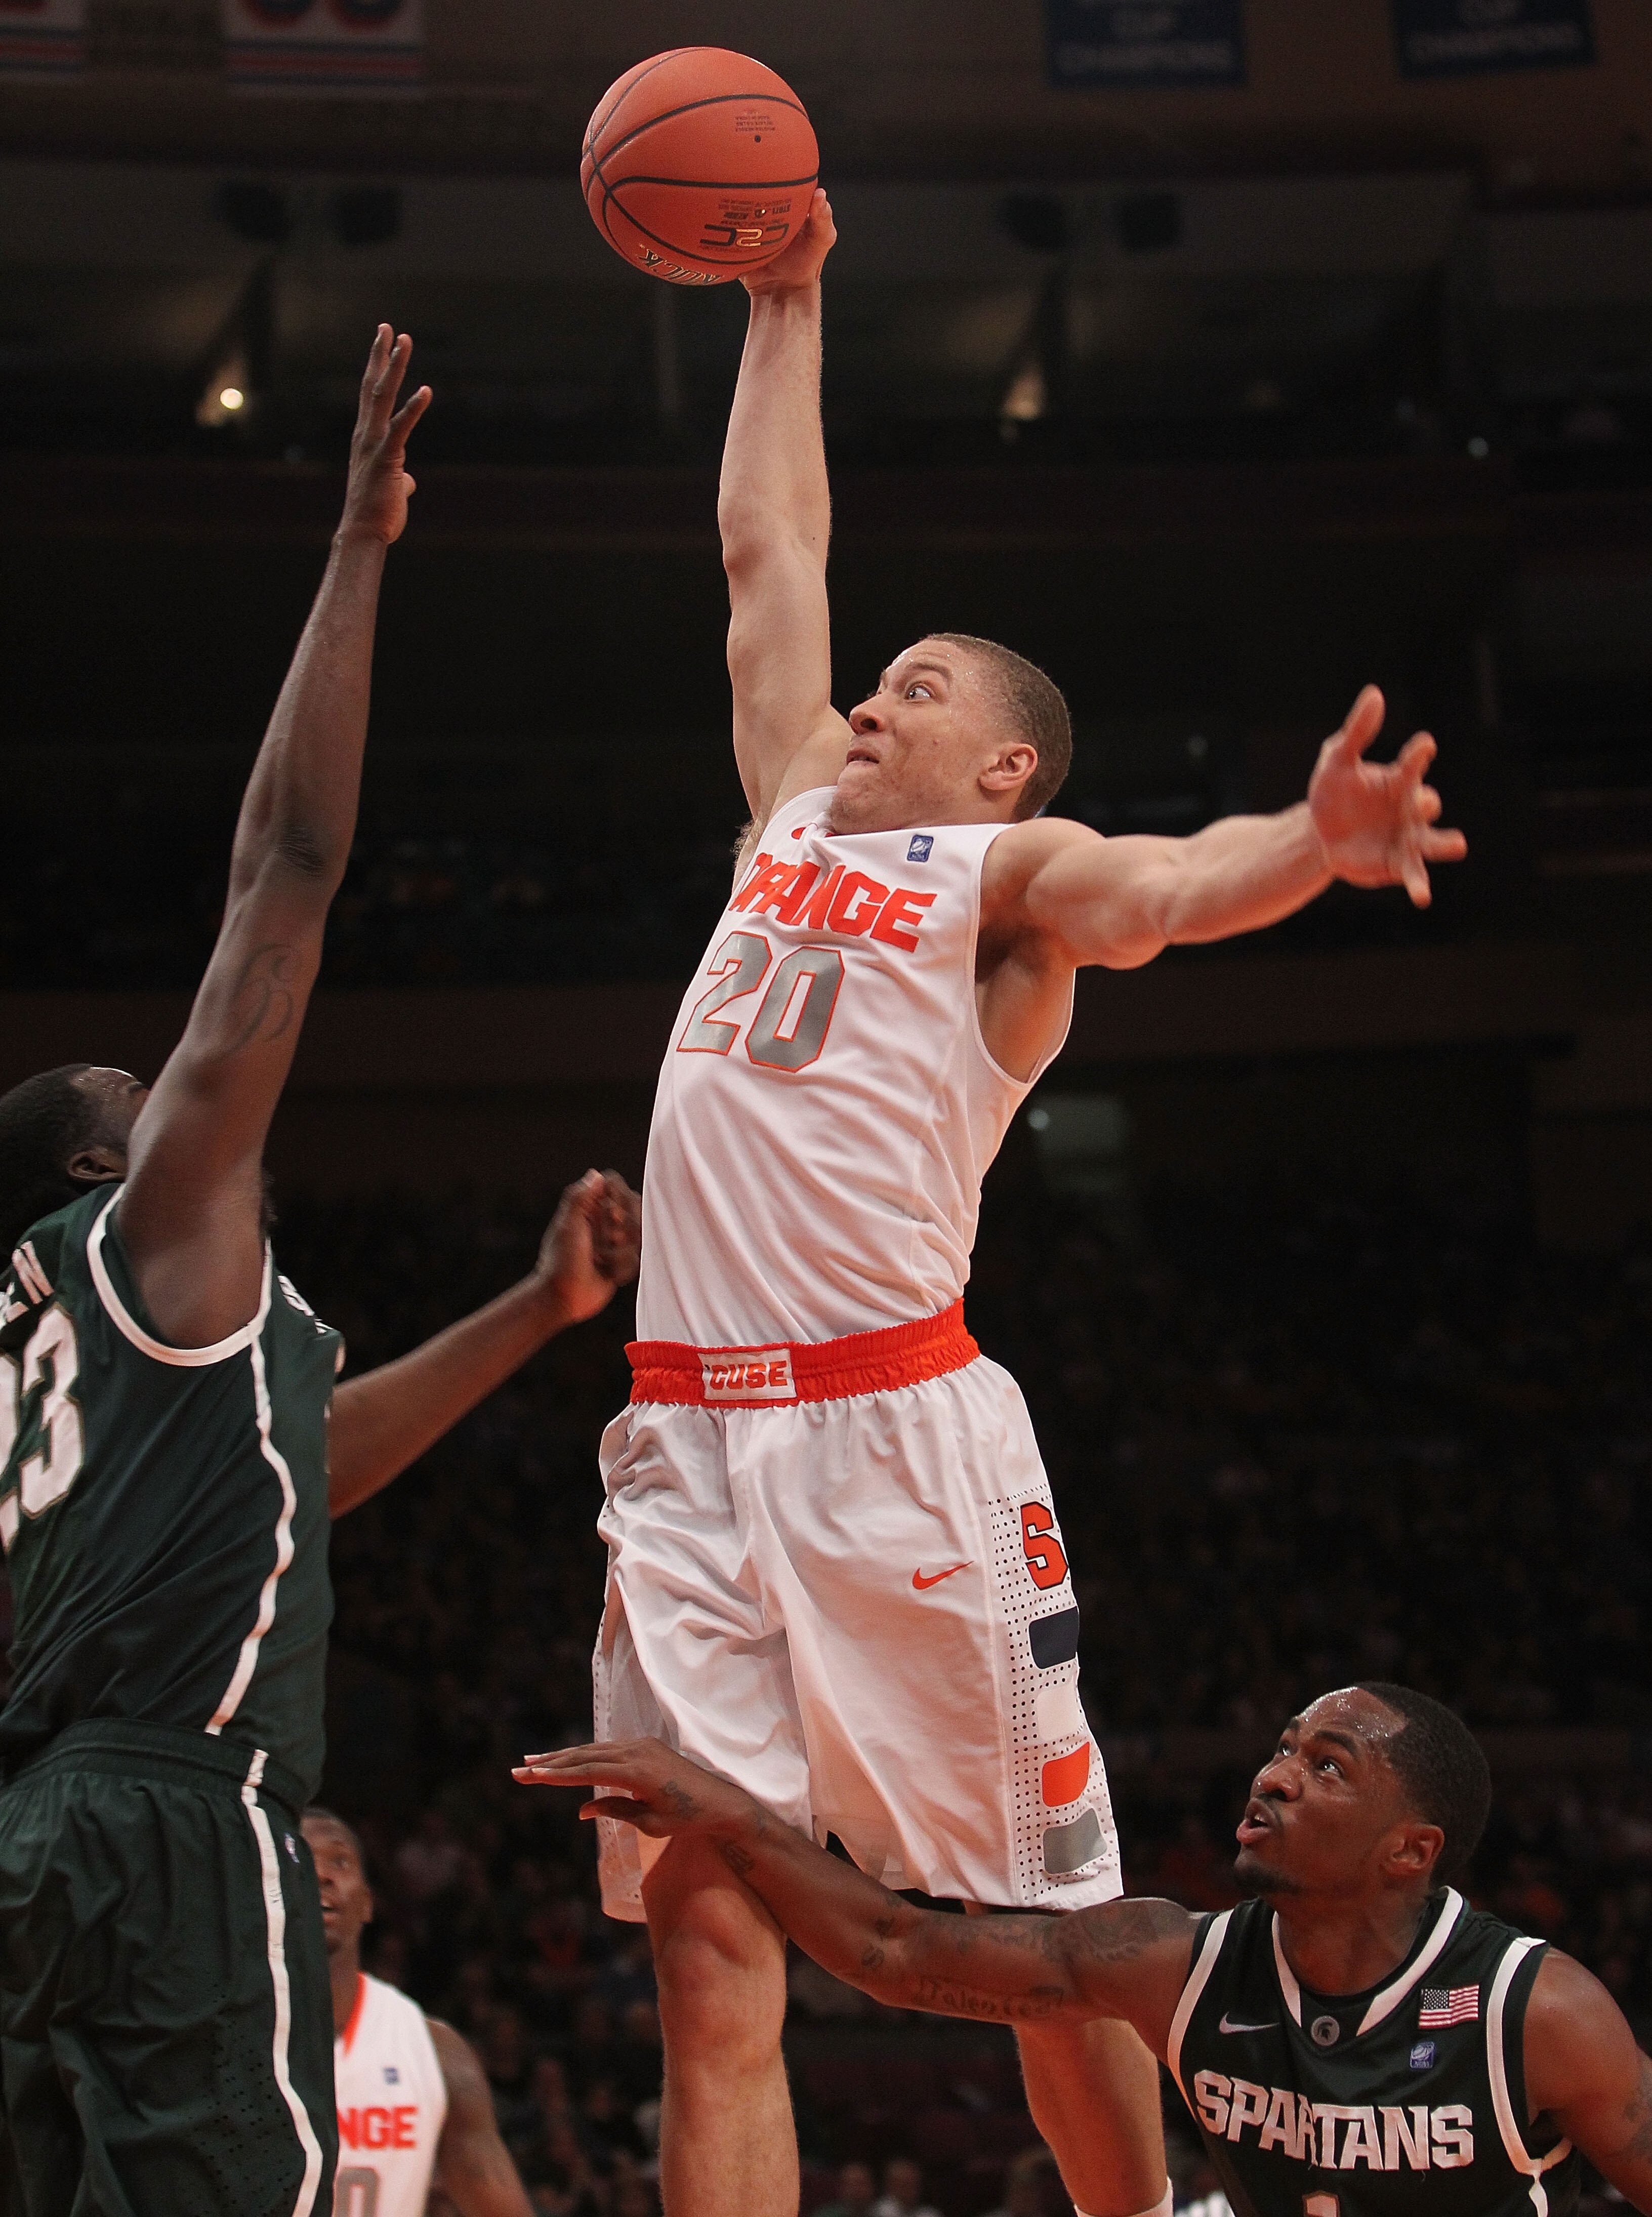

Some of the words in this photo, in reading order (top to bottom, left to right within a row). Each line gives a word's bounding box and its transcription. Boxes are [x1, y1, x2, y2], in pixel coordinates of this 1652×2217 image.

[728, 853, 937, 953] ORANGE
[677, 931, 845, 1072] 20
[1020, 1501, 1068, 1590] S
[1193, 2069, 1474, 2171] SPARTANS
